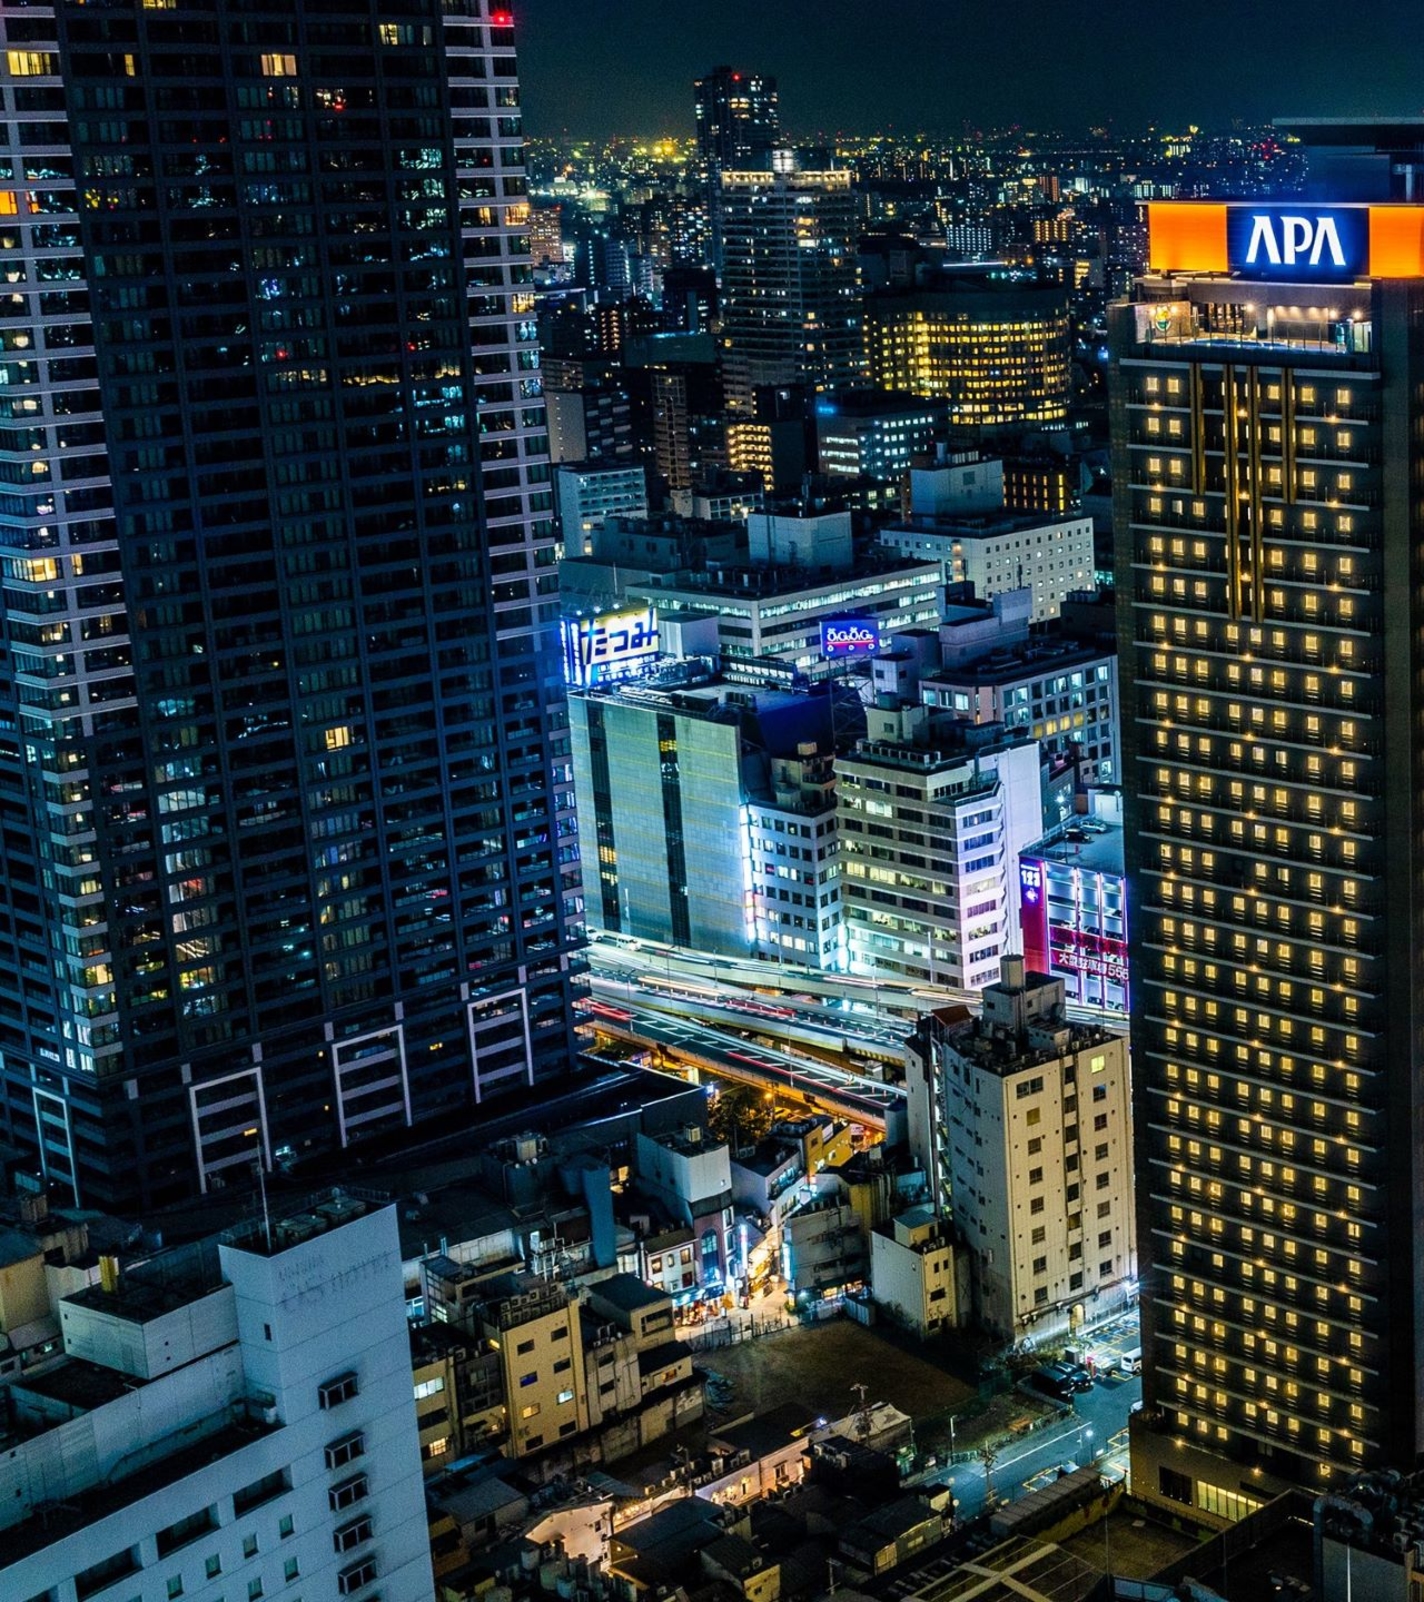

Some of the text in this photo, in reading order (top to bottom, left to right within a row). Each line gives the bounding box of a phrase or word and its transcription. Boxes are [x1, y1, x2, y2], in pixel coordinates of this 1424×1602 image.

[1245, 215, 1347, 266] APA
[580, 607, 659, 665] たつみ
